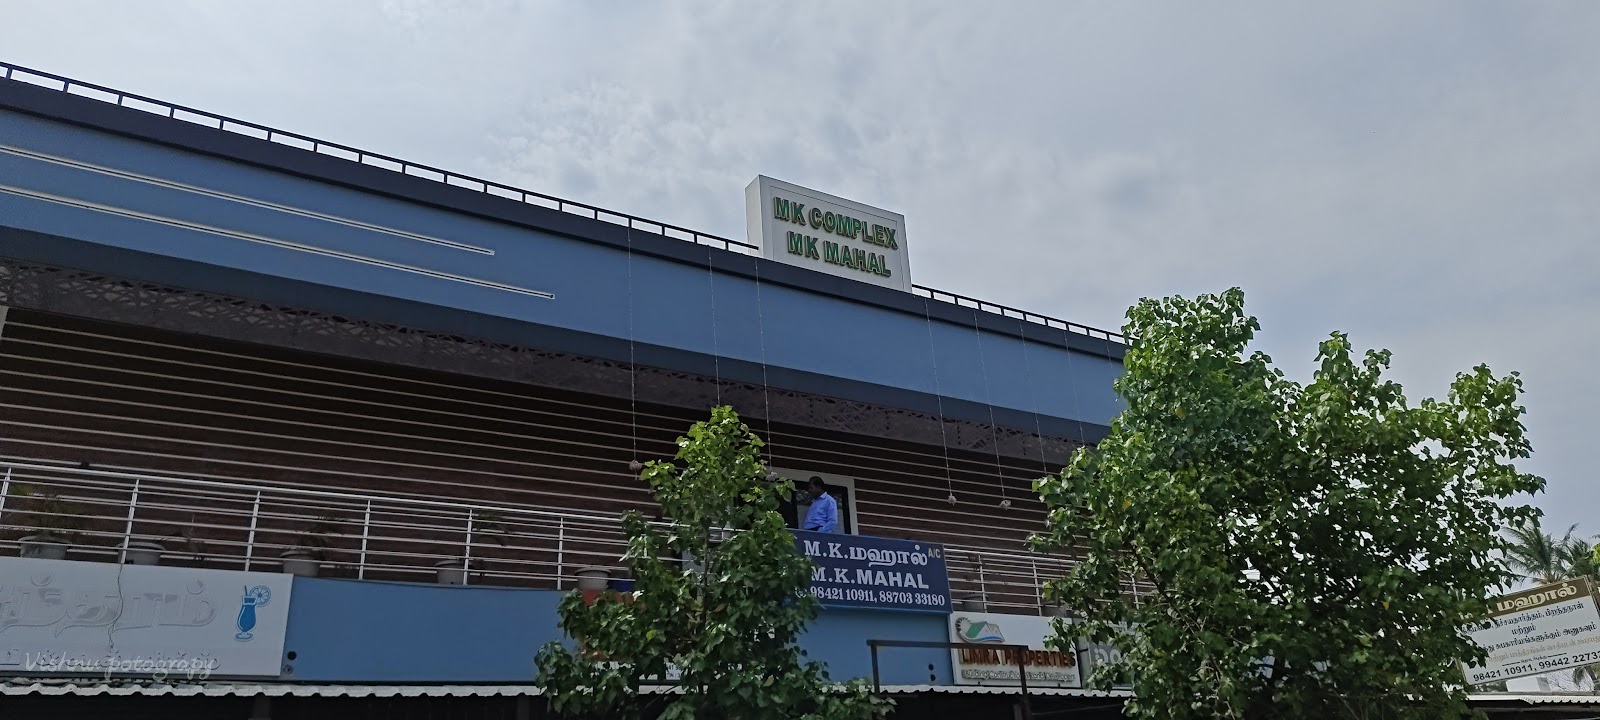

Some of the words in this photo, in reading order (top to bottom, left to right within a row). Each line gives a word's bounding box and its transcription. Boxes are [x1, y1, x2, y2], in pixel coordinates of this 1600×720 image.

[773, 196, 806, 226] MK
[808, 206, 898, 249] COMPLEX
[787, 230, 820, 260] MK
[822, 240, 892, 277] MAHAL
[928, 547, 941, 559] A/C
[811, 565, 930, 589] M.K.MAHAL
[810, 586, 843, 600] 98421
[845, 587, 878, 603] 10911,
[879, 590, 913, 603] 88703
[914, 591, 945, 606] 33180
[1496, 582, 1577, 612] மஹால்
[1511, 622, 1536, 636] மற்றும்
[958, 648, 1001, 665] LIMRA
[1473, 670, 1501, 682] 98421
[1504, 663, 1537, 676] 10911,
[1538, 657, 1570, 670] 99442
